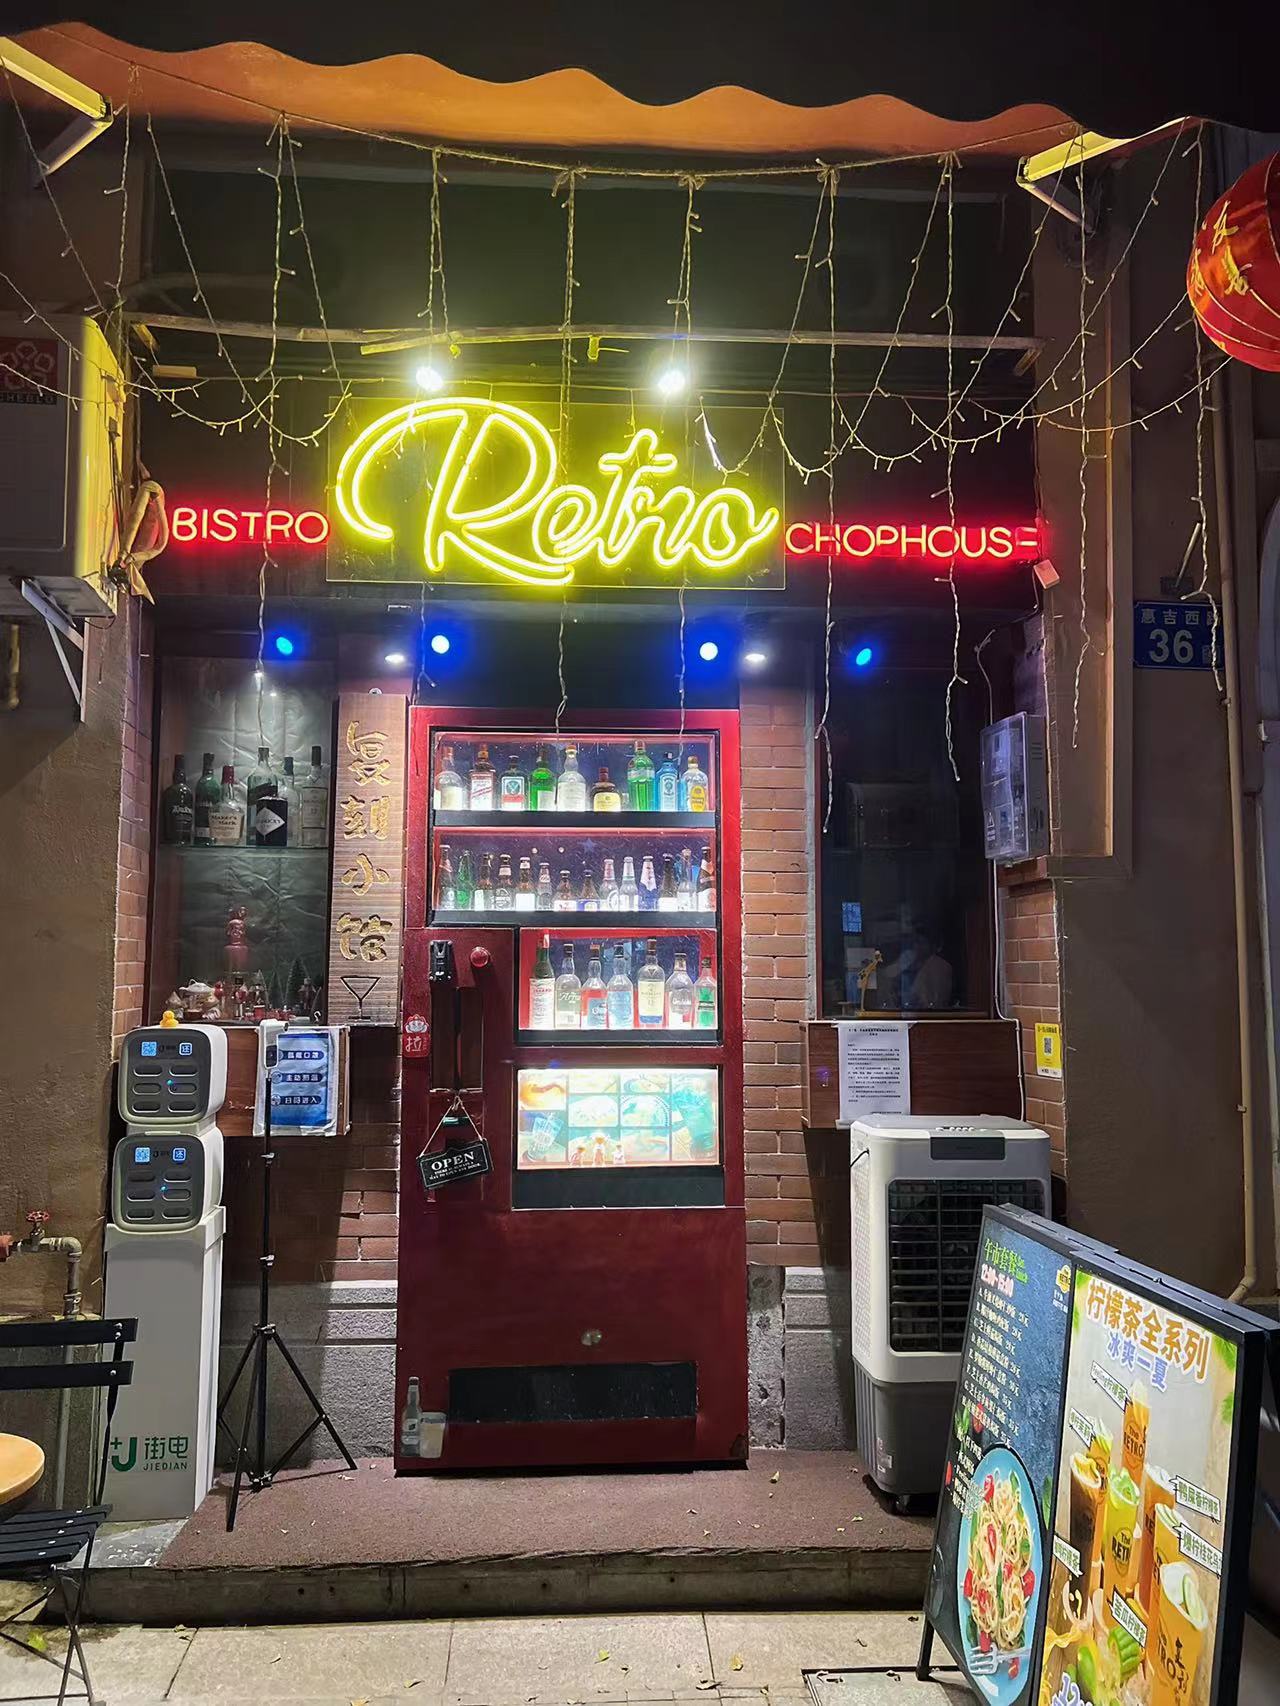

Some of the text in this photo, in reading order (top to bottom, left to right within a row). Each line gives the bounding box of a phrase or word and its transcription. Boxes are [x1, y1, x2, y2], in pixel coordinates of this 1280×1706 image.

[336, 397, 780, 586] Retro
[171, 506, 329, 545] BISTRO
[785, 522, 1039, 559] CHOPHOUSE
[1149, 628, 1194, 664] 36
[405, 1035, 422, 1053] 拉
[431, 1151, 475, 1171] OPEN
[1087, 1278, 1211, 1381] 柠檬茶全系列
[1107, 1330, 1169, 1390] 冰爽一夏
[144, 1435, 189, 1460] 街电
[143, 1462, 188, 1471] JIEDIAN
[1182, 1529, 1222, 1570] 爆柠桂花乌
